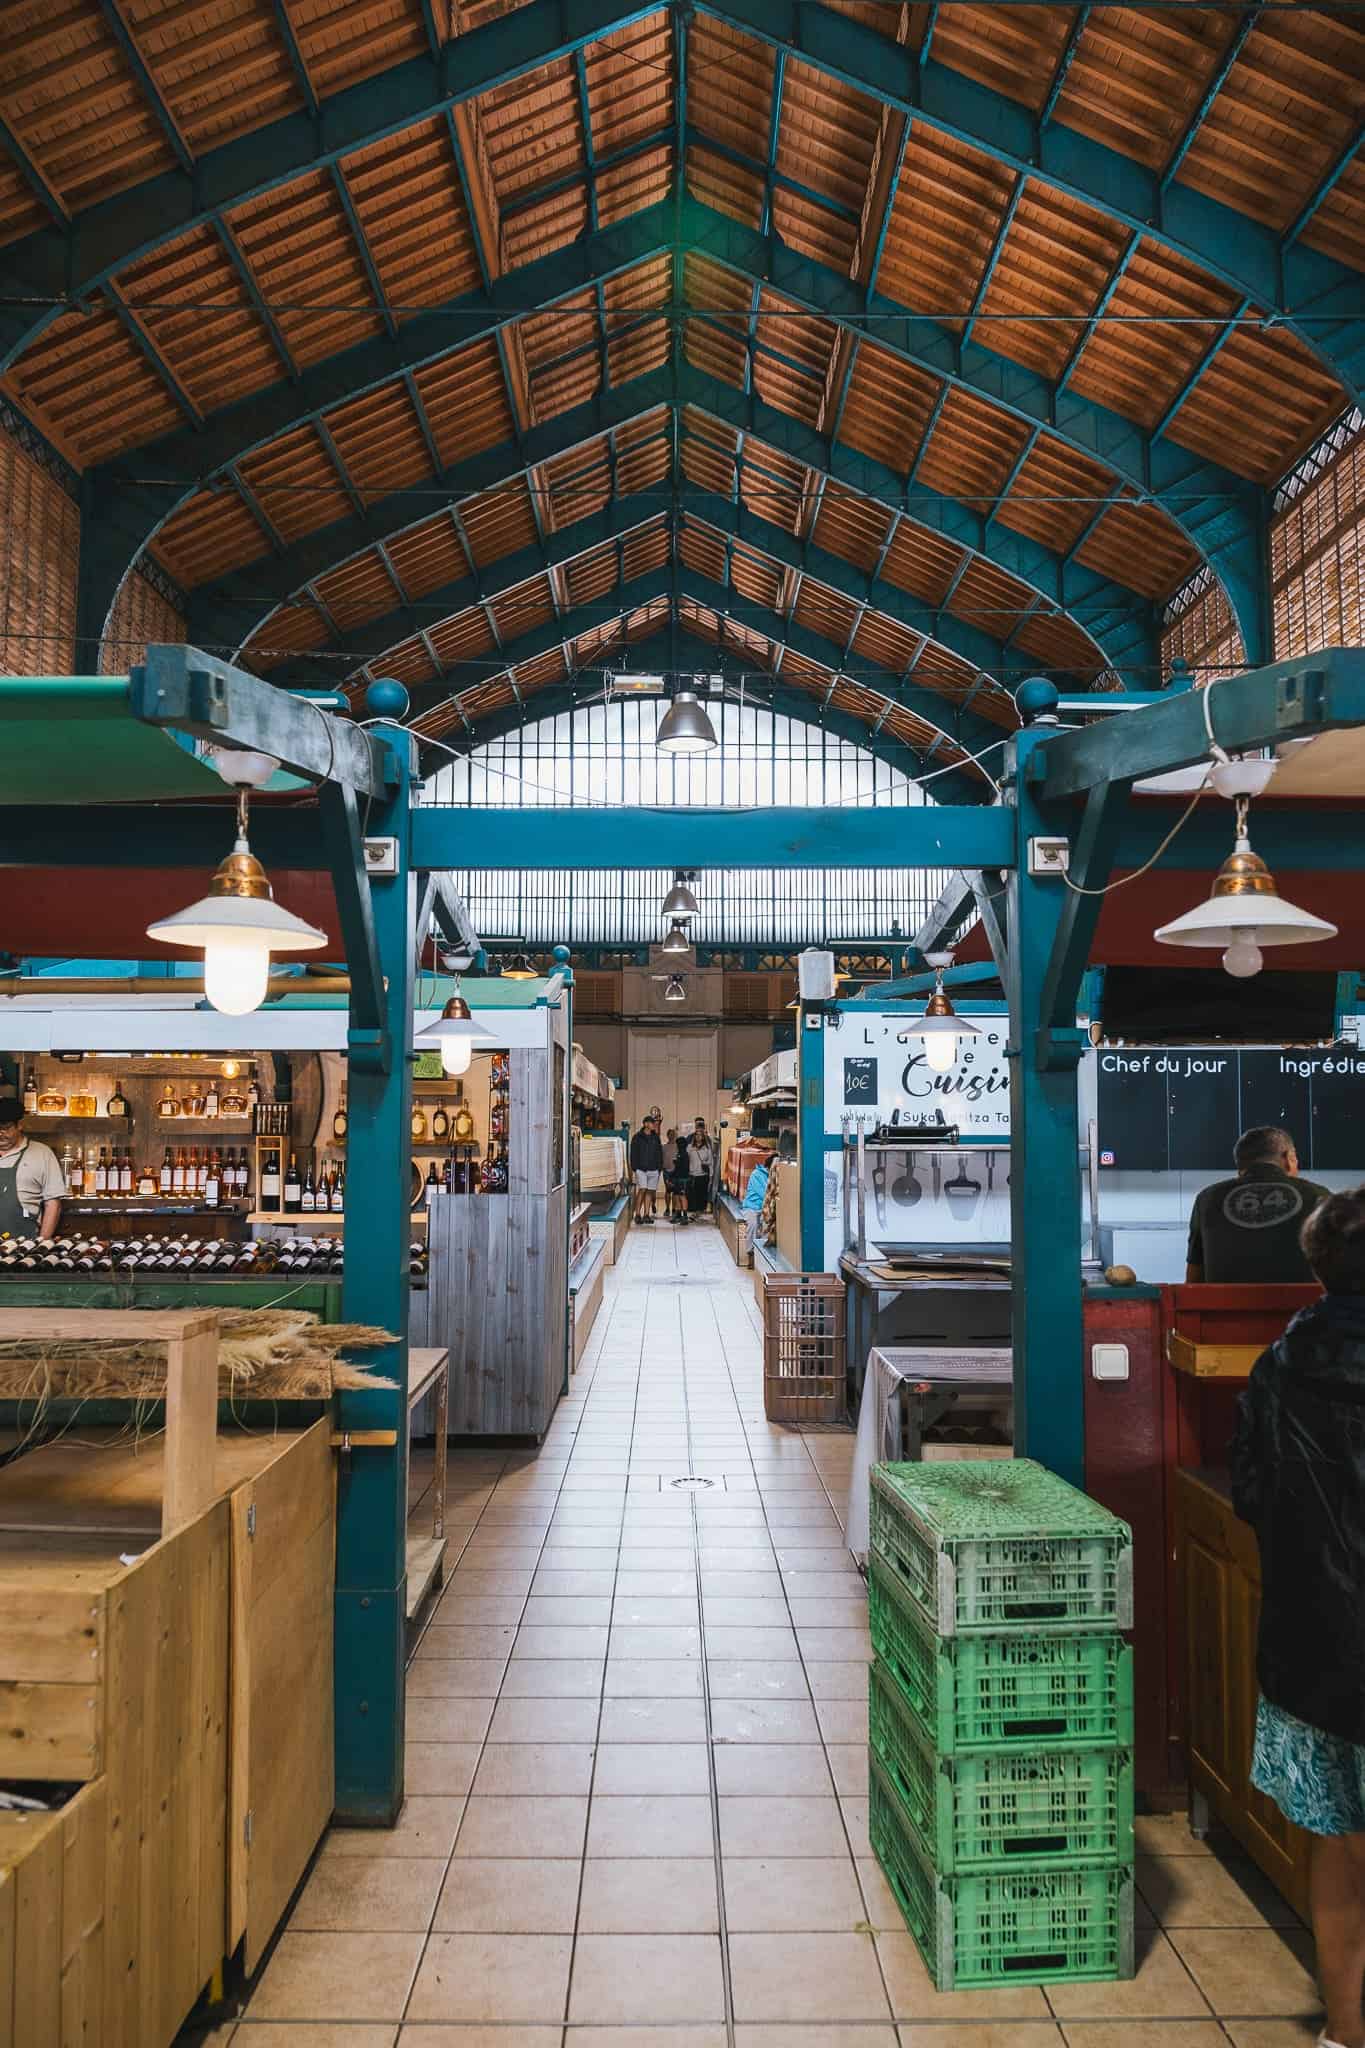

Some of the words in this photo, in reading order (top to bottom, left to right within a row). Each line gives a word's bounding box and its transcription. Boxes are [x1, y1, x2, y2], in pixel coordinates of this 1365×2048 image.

[1101, 1055, 1151, 1073] Chef
[1155, 1056, 1180, 1073] du
[1184, 1057, 1227, 1078] jour
[1280, 1055, 1365, 1078] Ingrédie
[1236, 1190, 1289, 1214] 64
